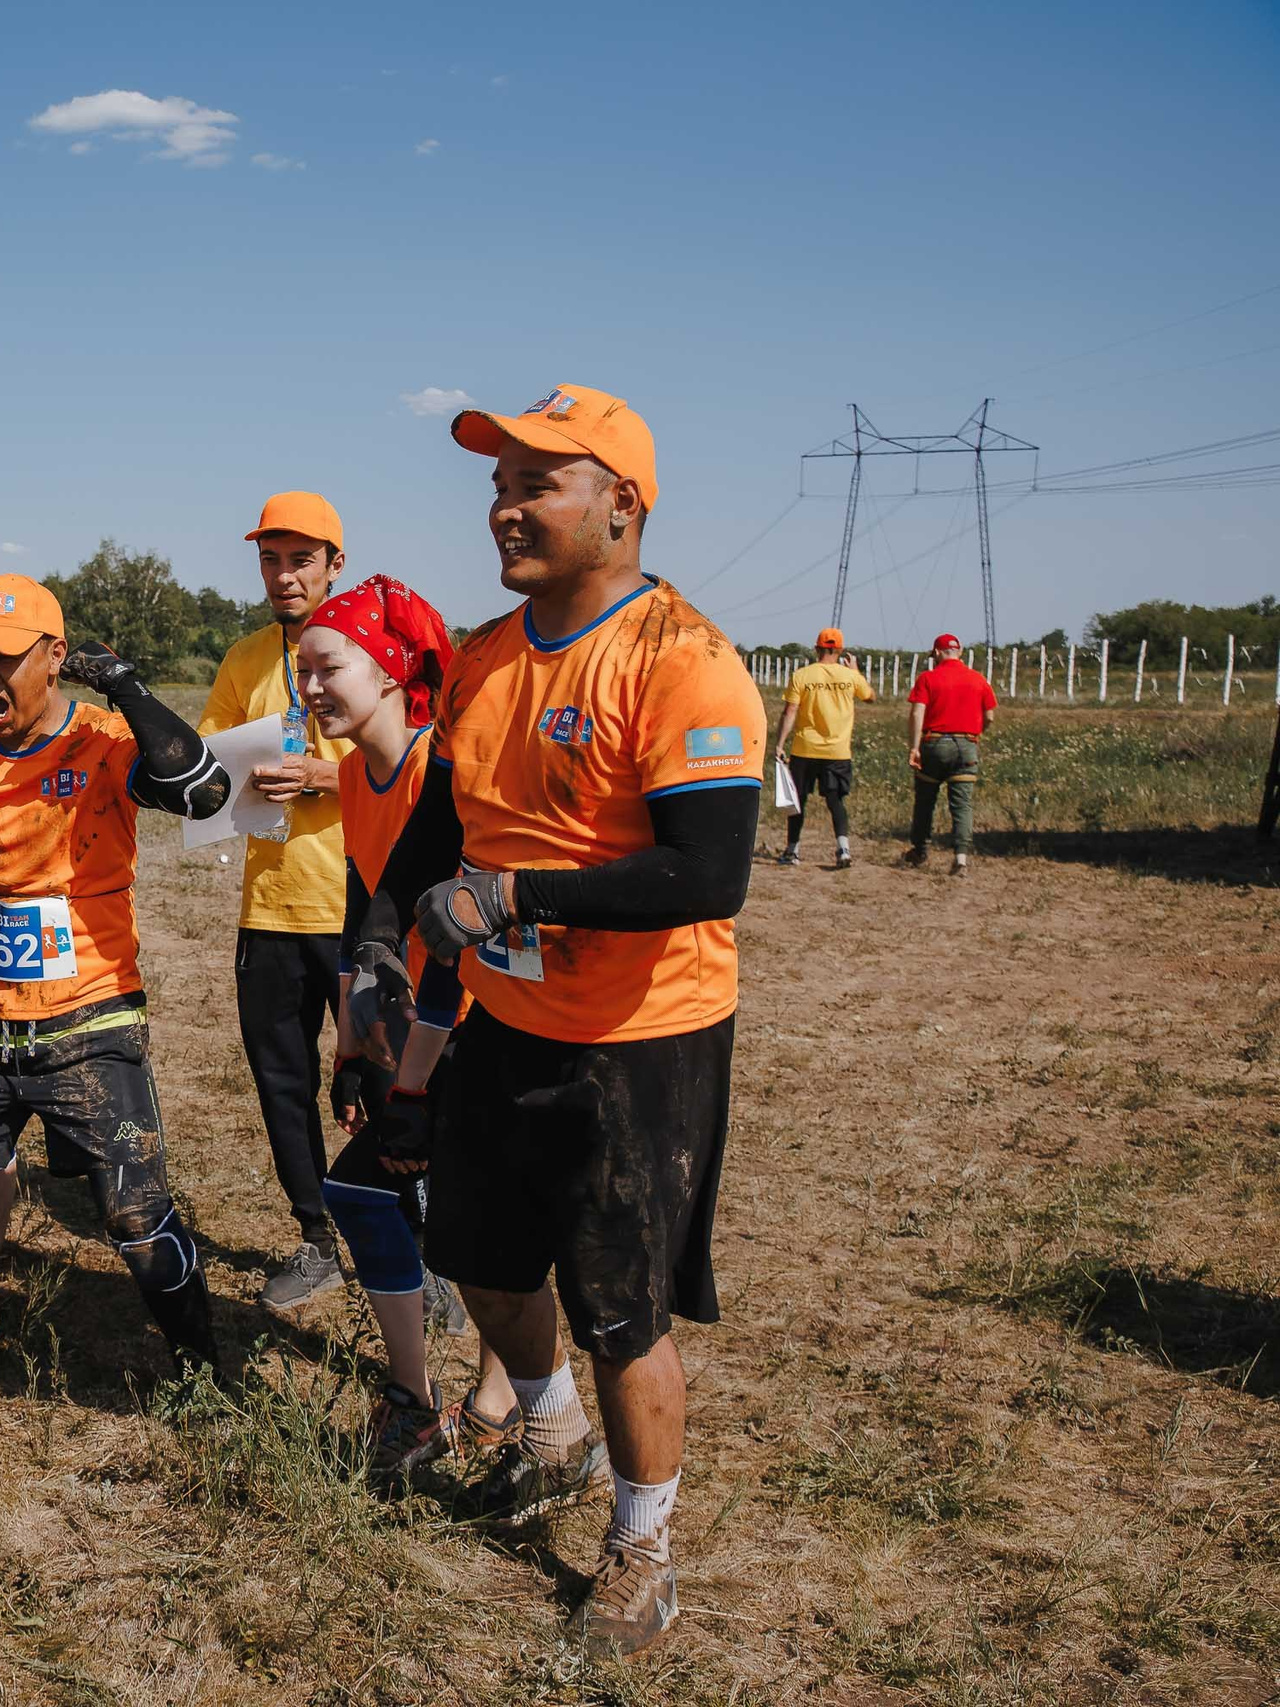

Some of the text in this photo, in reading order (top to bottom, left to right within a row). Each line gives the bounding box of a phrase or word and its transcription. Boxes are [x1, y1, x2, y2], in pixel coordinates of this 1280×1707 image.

[561, 711, 576, 724] BI
[555, 728, 569, 738] RACE
[686, 758, 744, 769] KAZAKHSTAN
[60, 772, 70, 783] BI
[9, 920, 30, 928] RACE
